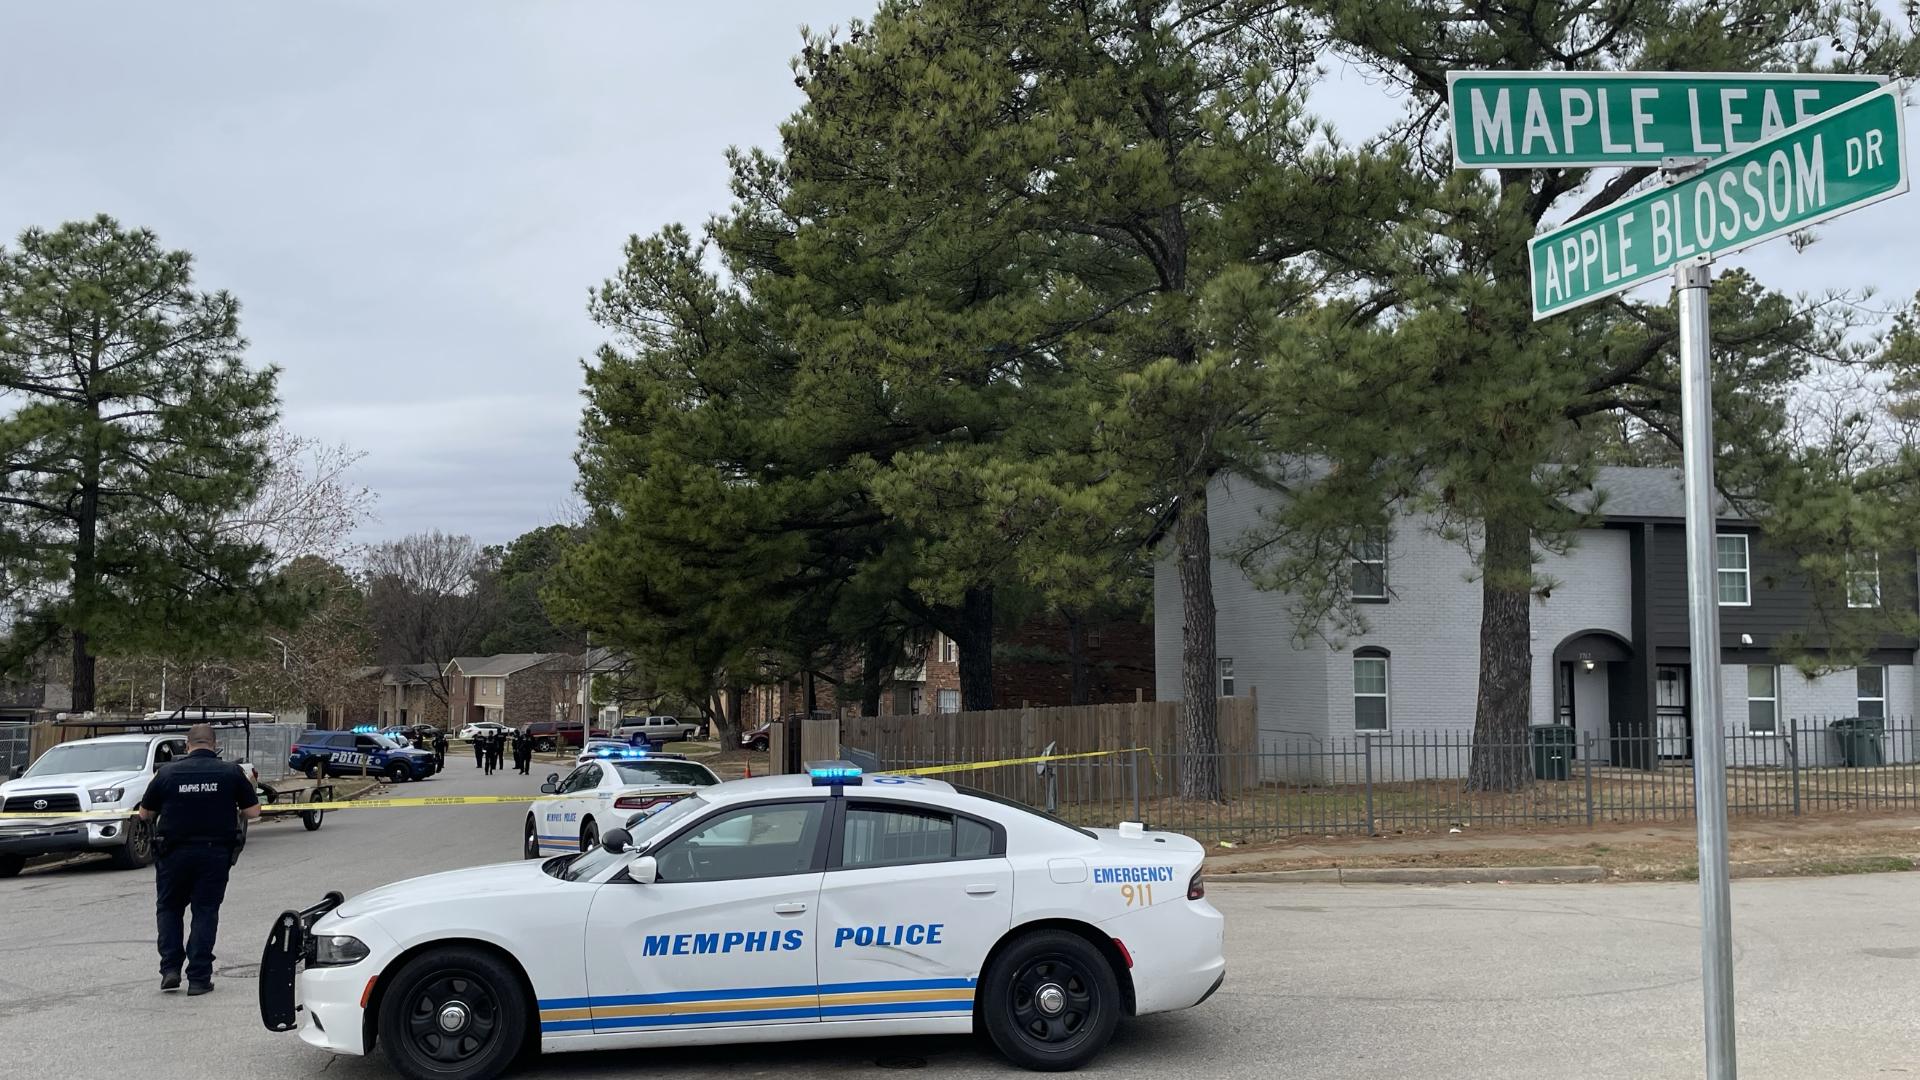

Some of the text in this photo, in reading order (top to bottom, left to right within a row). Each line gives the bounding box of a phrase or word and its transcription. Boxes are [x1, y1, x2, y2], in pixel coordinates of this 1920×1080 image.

[1470, 87, 1821, 155] MAPLE LEAF
[1544, 128, 1884, 306] APPLE BLOSSOM DR
[328, 752, 375, 766] POLICE
[178, 782, 218, 793] MEMPHIS POLICE
[564, 812, 577, 822] POLICE
[1093, 866, 1174, 884] EMERGENCY
[1121, 883, 1153, 907] 911
[642, 923, 945, 957] MEMPHIS POLICE
